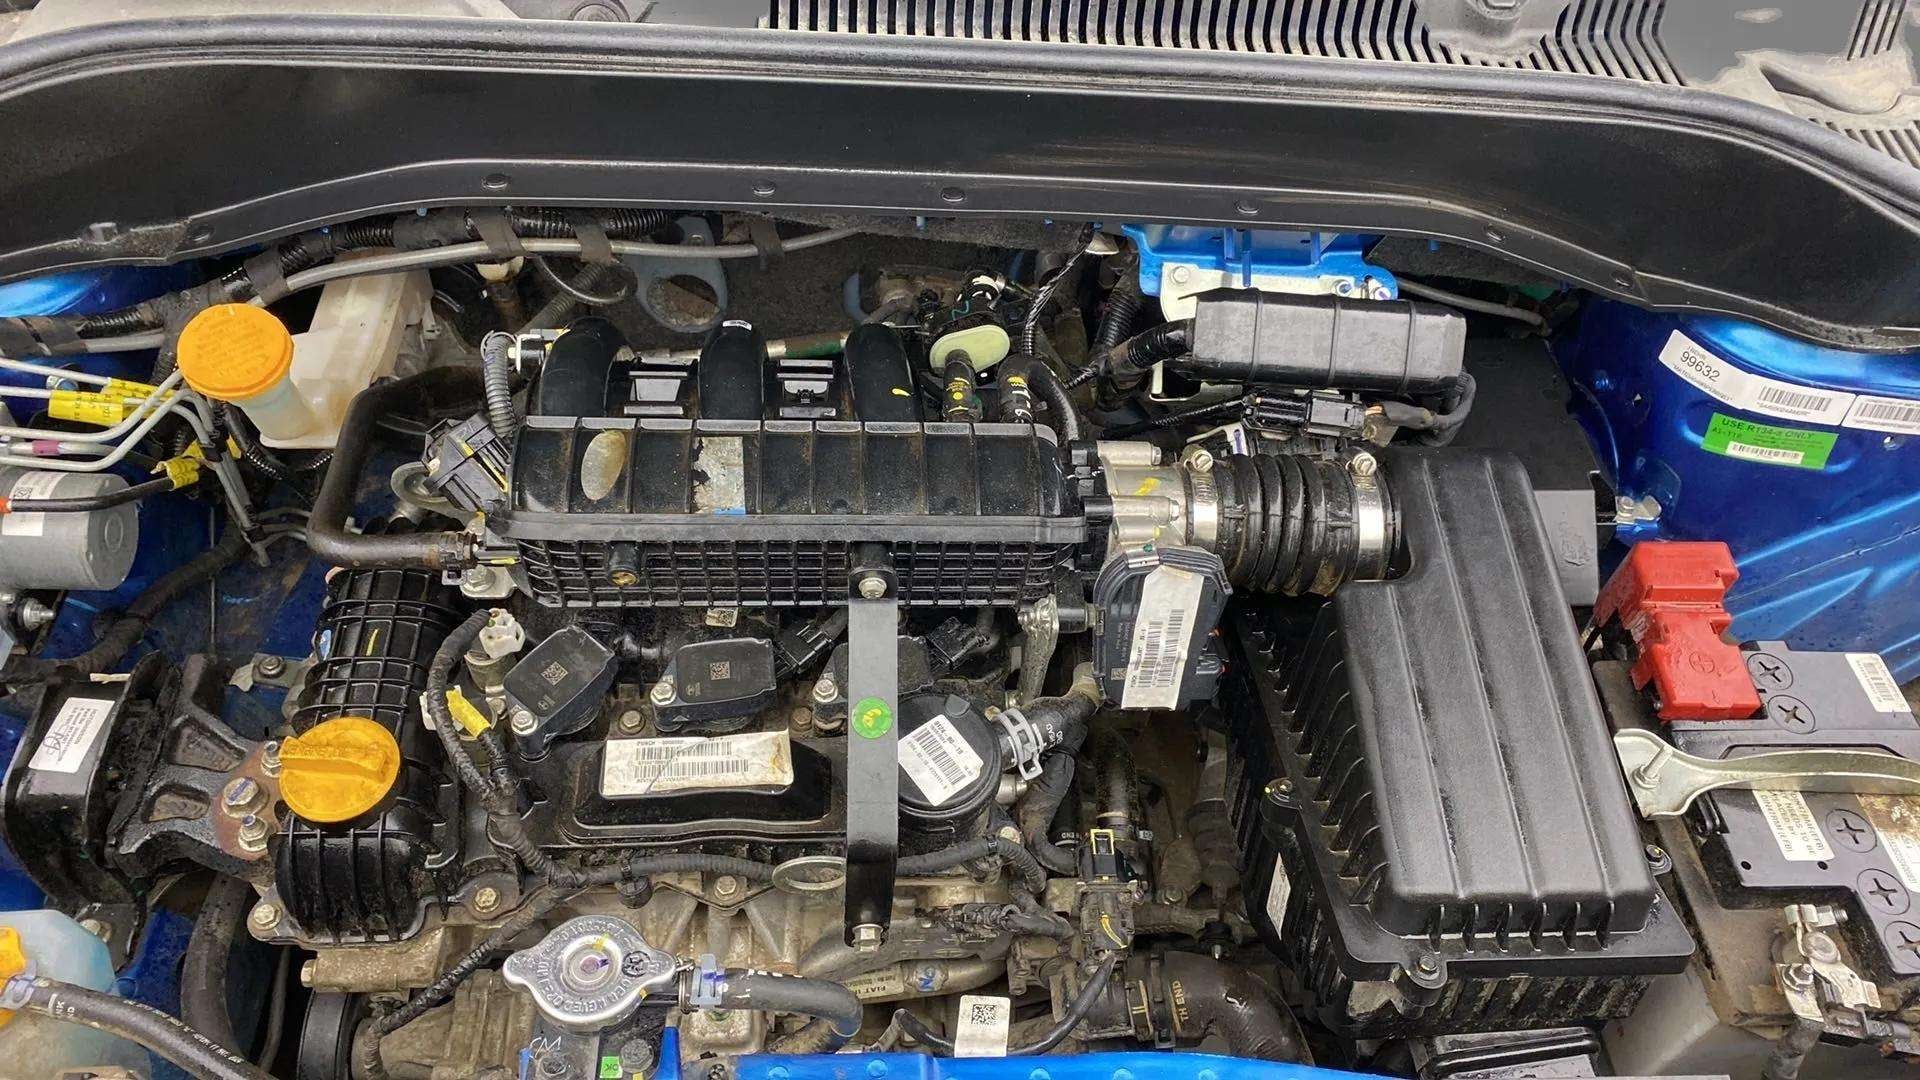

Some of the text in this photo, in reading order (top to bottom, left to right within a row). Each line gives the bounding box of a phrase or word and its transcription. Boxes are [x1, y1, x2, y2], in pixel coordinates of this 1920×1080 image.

[1681, 351, 1720, 382] 99632
[1721, 417, 1745, 430] USE
[1785, 430, 1815, 440] ONLY
[865, 985, 886, 994] FIAT
[1172, 980, 1186, 1005] END
